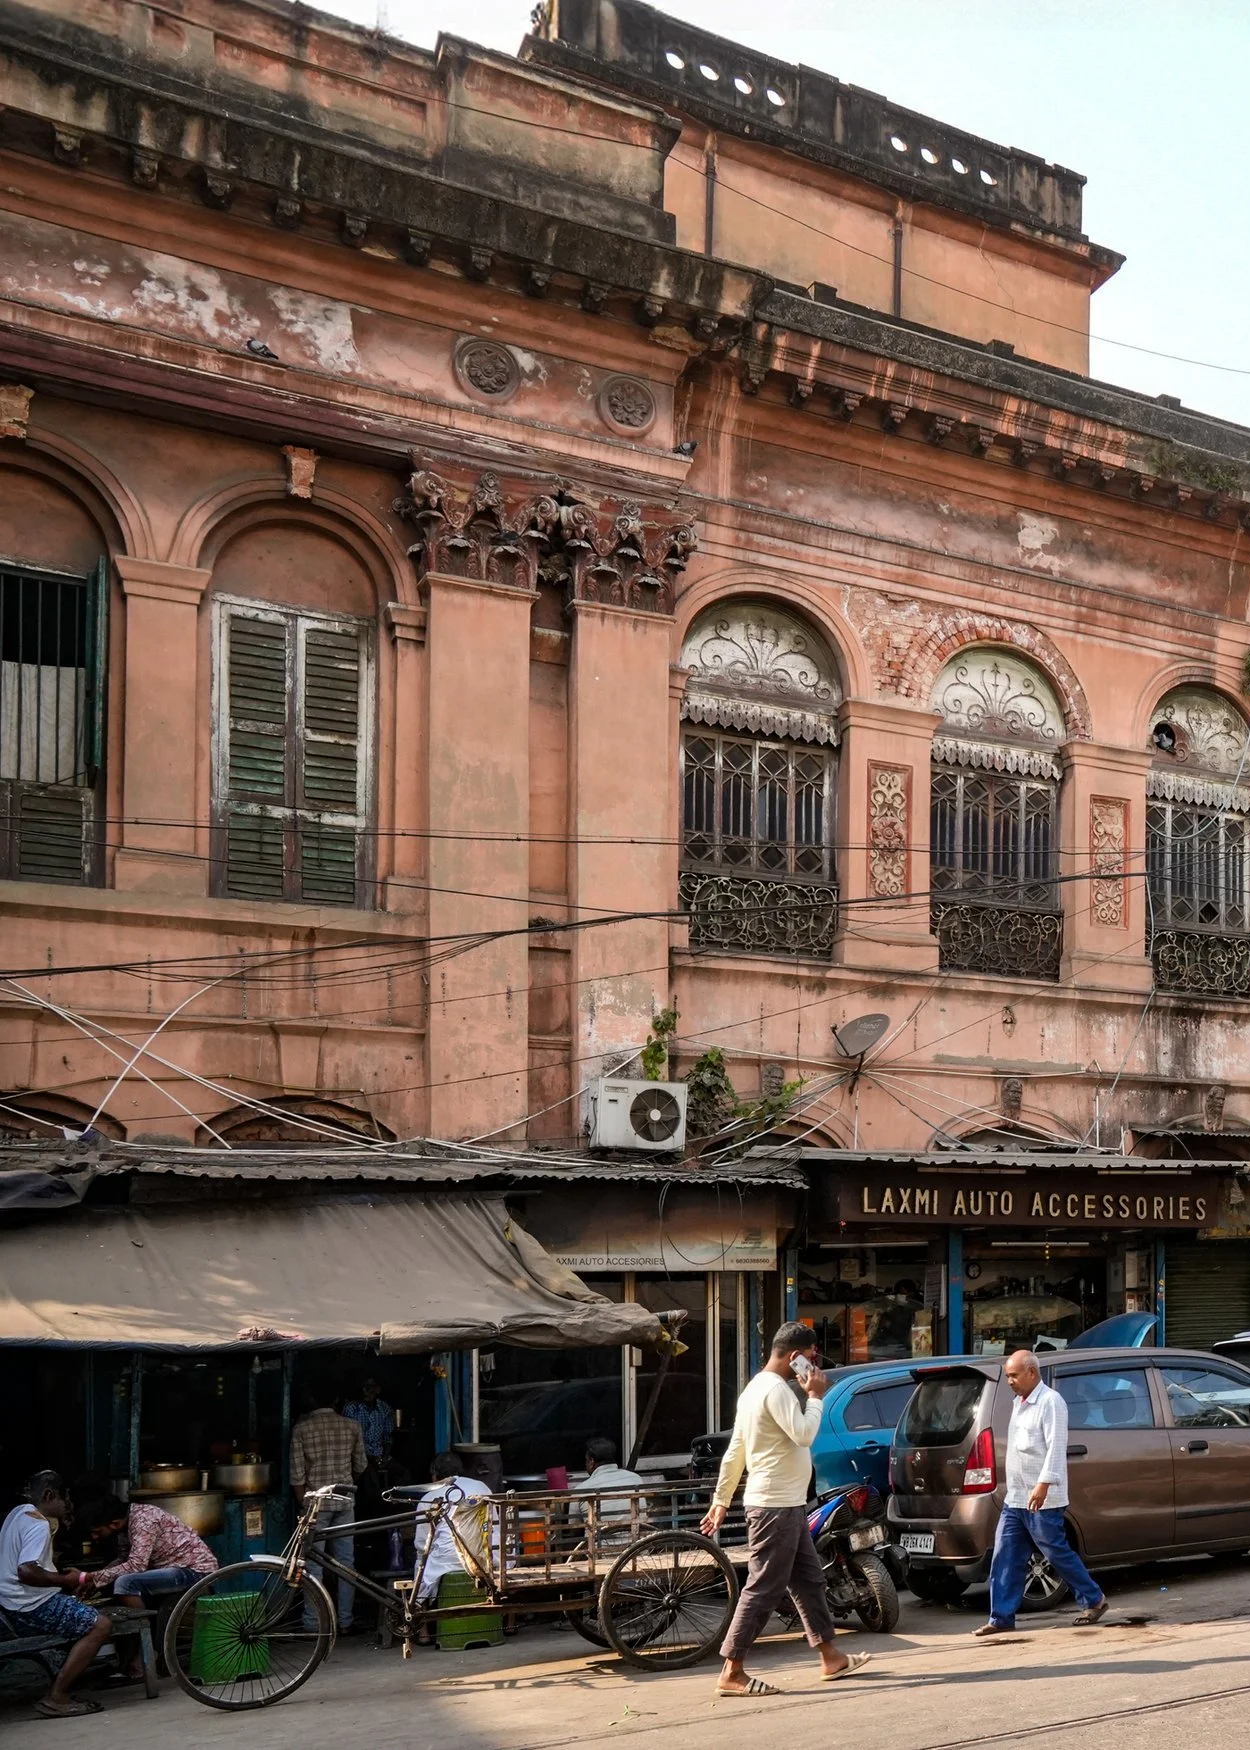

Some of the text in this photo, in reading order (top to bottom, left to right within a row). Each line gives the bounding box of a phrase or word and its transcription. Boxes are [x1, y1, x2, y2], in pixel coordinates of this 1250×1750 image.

[863, 1187, 1206, 1220] LAXMI AUTO ACCESSORIES
[556, 1257, 578, 1266] AXMI
[579, 1257, 605, 1266] AUTO
